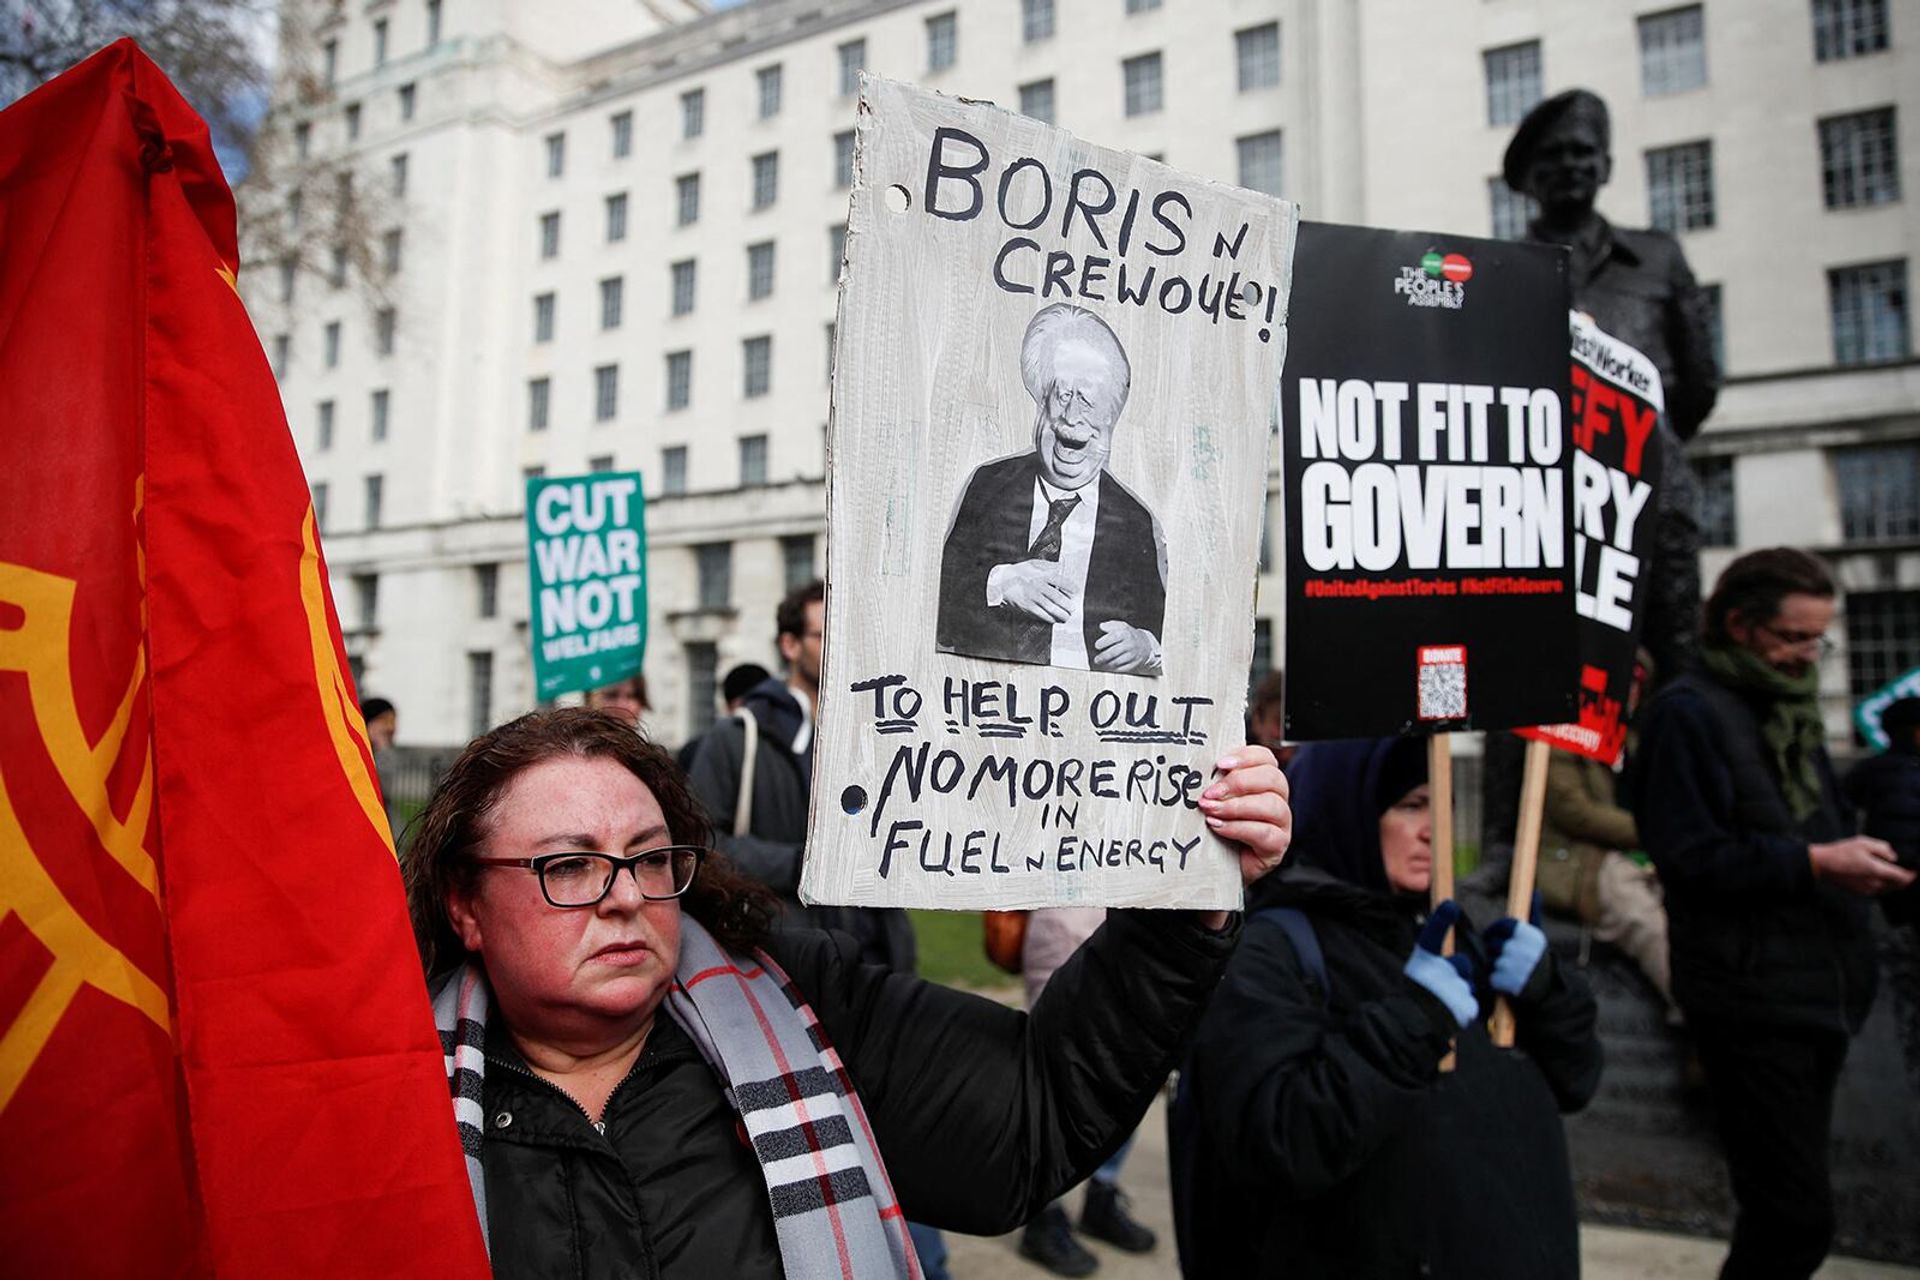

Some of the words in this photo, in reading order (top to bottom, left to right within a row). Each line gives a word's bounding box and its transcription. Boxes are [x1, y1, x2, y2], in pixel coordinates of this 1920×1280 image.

[925, 127, 1193, 257] BORIS
[1401, 266, 1427, 279] THE
[1299, 377, 1409, 461] NOT
[1417, 382, 1494, 462] FIT
[1500, 386, 1562, 466] TO
[1570, 364, 1657, 477] EFY
[535, 478, 636, 536] CUT
[1301, 461, 1564, 571] GOVERN
[1573, 448, 1652, 552] RY
[535, 528, 641, 585] WAR
[1575, 531, 1640, 632] LE
[540, 574, 641, 637] NOT
[850, 675, 923, 719] TO
[944, 677, 1071, 735] HELP
[1089, 690, 1214, 738] OUT
[1042, 802, 1078, 830] IN
[878, 820, 1010, 879] FUEL
[1056, 835, 1202, 874] ENERGY
